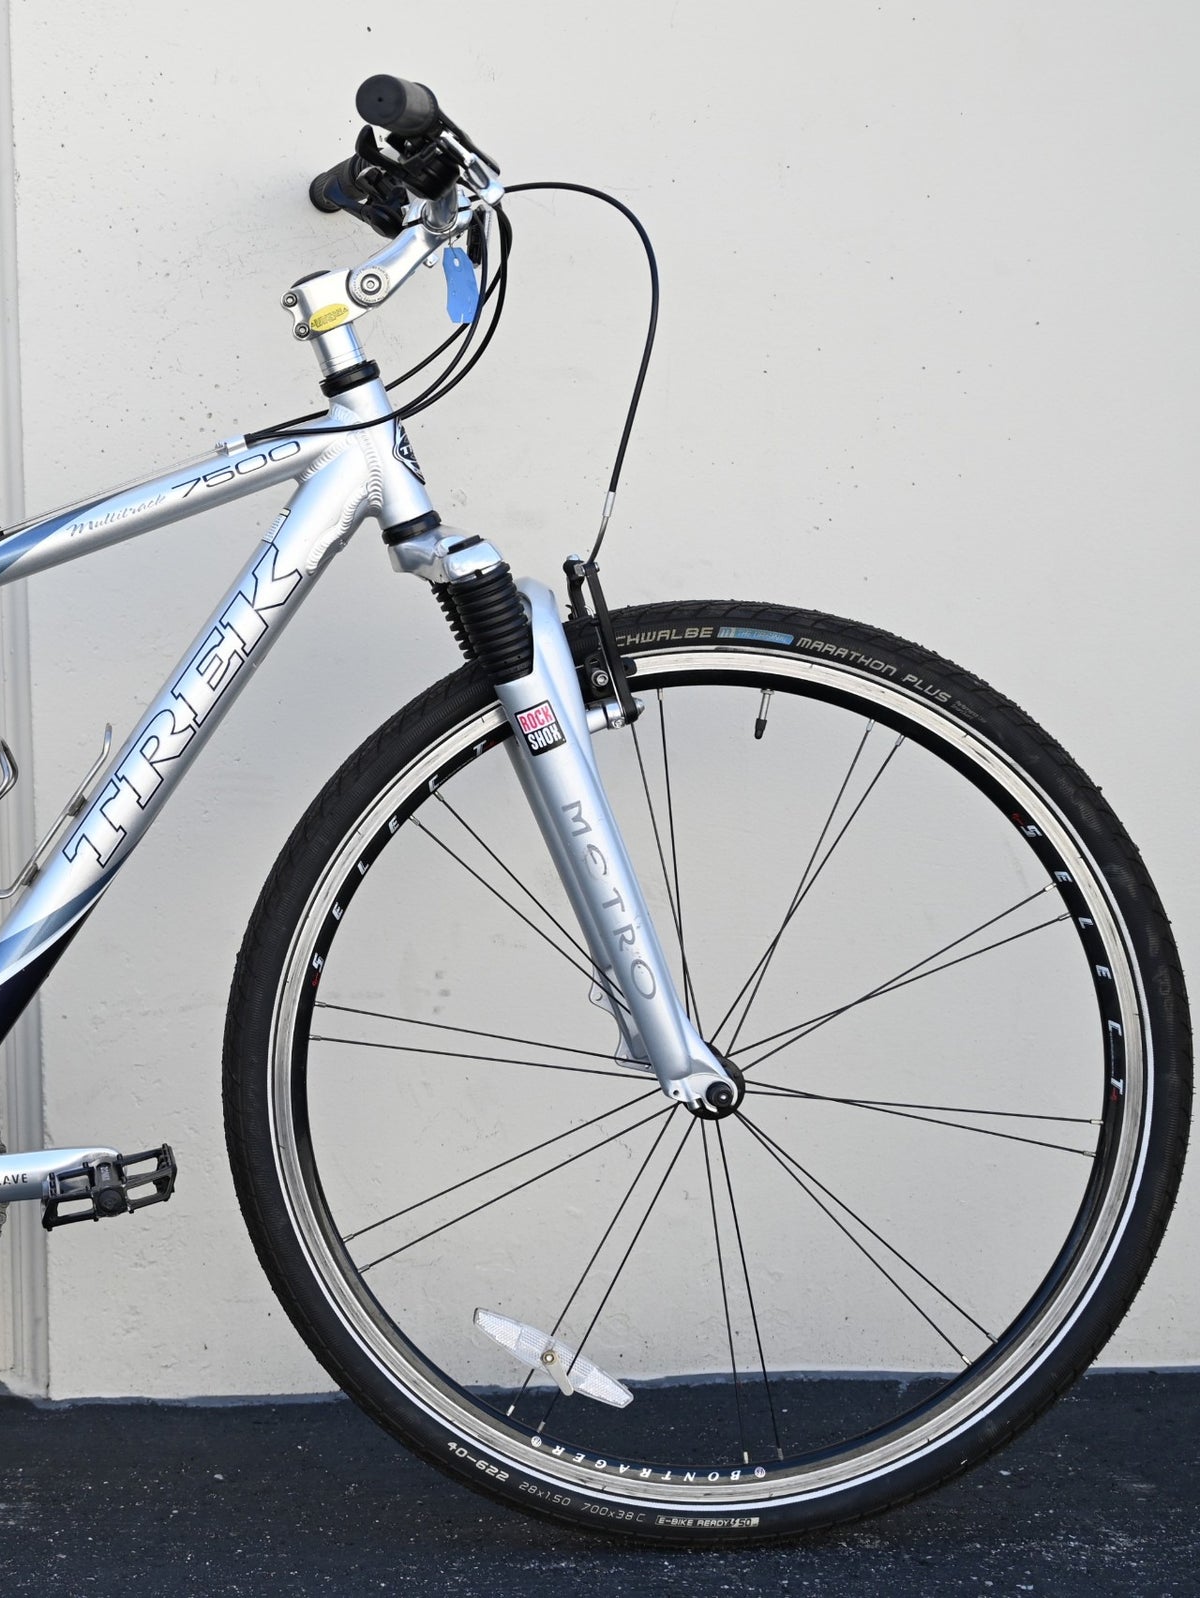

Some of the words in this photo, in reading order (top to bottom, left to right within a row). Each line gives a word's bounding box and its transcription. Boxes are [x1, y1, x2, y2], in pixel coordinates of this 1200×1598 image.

[65, 492, 167, 538] Multitrack
[170, 439, 302, 499] 7500
[615, 626, 714, 647] CHWALBE
[796, 637, 898, 677] MARATHON
[902, 673, 952, 704] PLUS
[62, 542, 303, 869] TREK
[518, 703, 554, 733] ROCK
[527, 726, 563, 751] SHOX
[1018, 823, 1126, 1097] SELECT
[447, 1441, 510, 1483] 40-622
[658, 1516, 694, 1527] E-BIKE
[696, 1517, 729, 1528] READY
[551, 1444, 742, 1482] BONTRAGER
